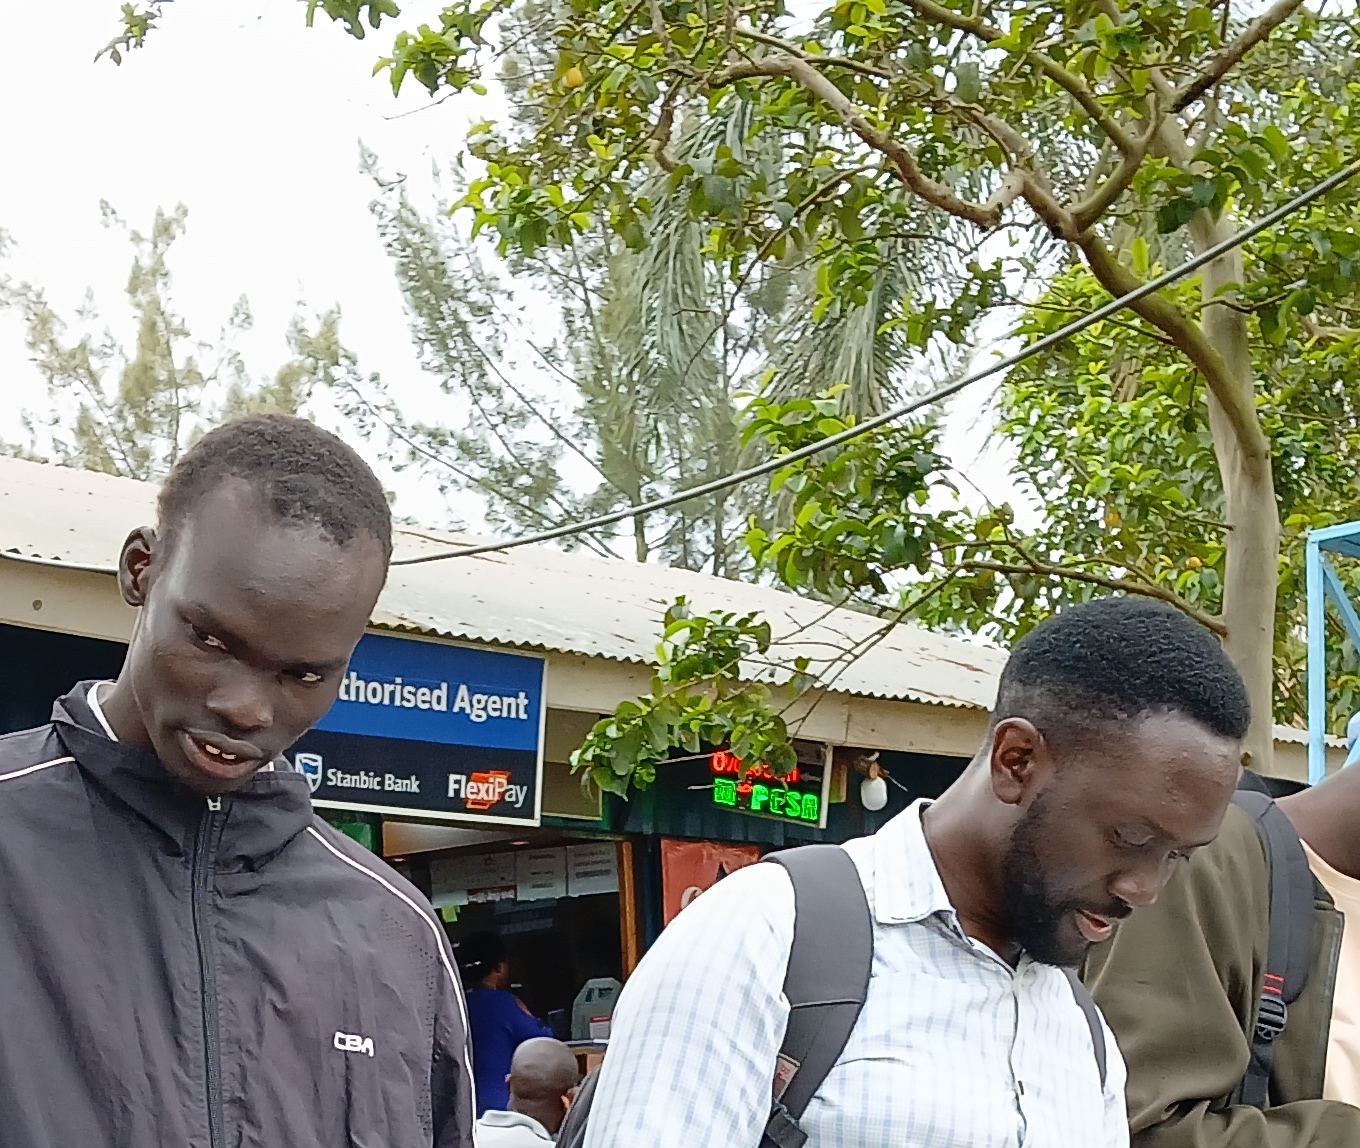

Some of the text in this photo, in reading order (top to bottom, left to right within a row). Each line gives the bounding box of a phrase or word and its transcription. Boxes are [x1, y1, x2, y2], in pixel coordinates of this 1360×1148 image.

[453, 684, 528, 722] Agent
[327, 768, 420, 793] Stanbic Bank
[448, 774, 527, 808] FlexiPay
[334, 1031, 375, 1057] CBA
